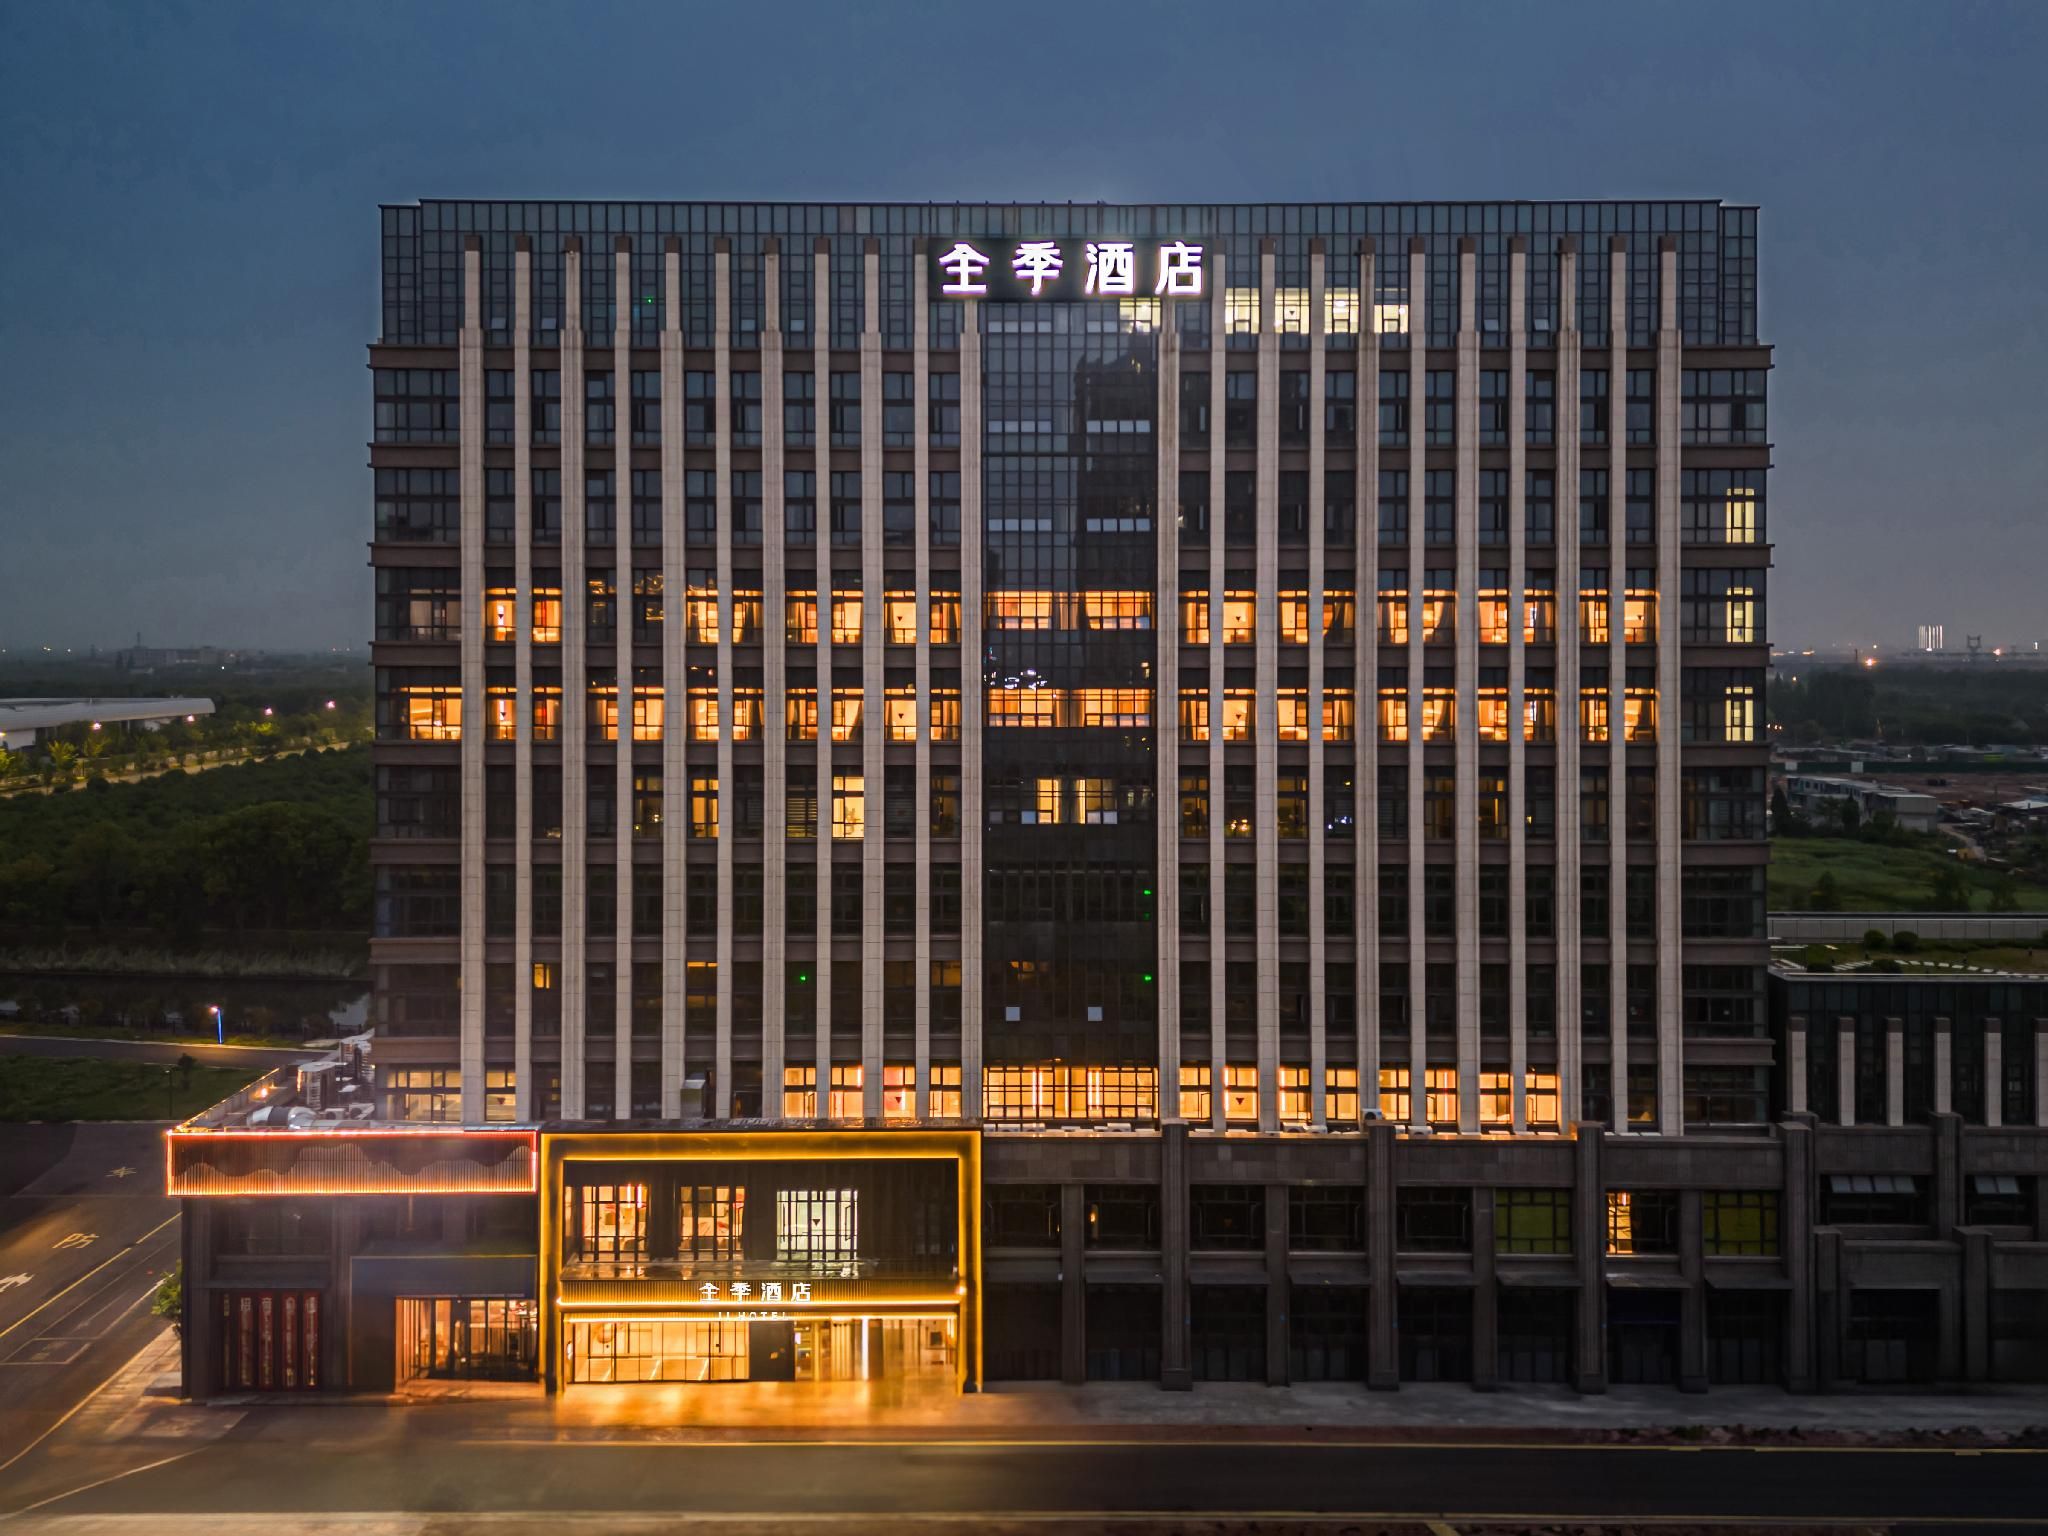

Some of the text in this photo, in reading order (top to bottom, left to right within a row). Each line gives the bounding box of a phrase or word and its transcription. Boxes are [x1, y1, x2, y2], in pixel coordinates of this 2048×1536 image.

[938, 241, 1204, 296] 全季酒店
[698, 1282, 812, 1302] 全季酒店
